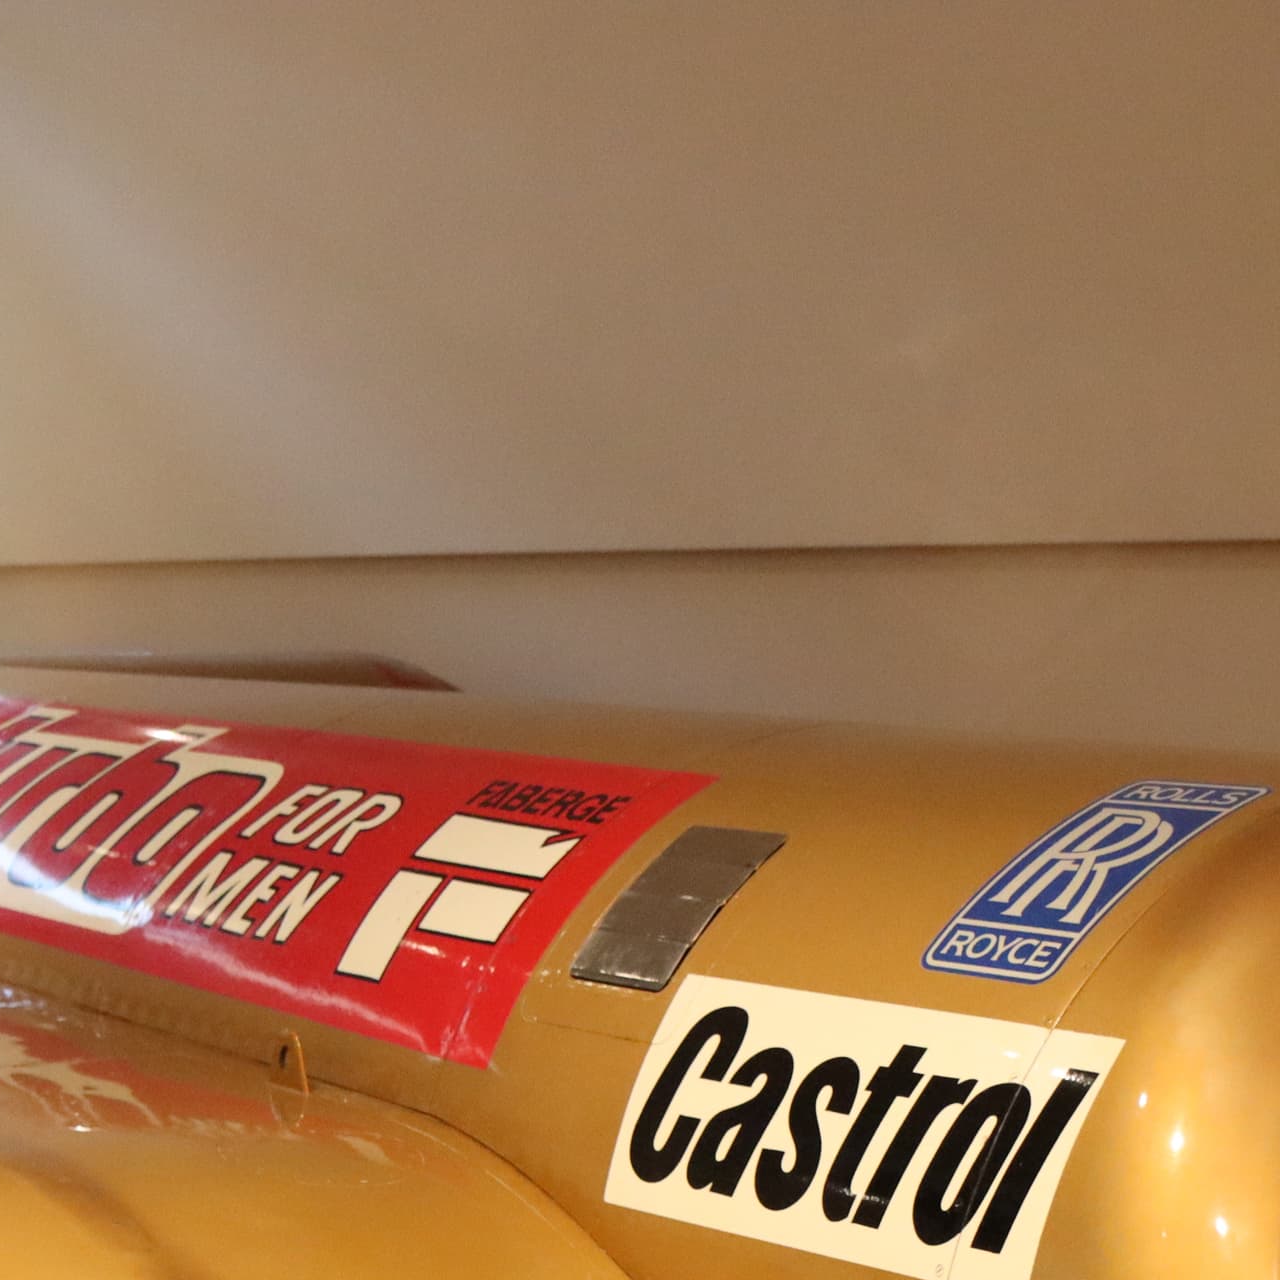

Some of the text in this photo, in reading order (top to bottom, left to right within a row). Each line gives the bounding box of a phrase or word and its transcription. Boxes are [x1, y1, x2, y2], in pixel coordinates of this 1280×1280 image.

[239, 784, 404, 855] FOR
[1124, 783, 1252, 807] ROLLS
[162, 850, 344, 944] MEN
[939, 931, 1062, 969] ROYCE
[628, 1004, 1100, 1255] Castrol
